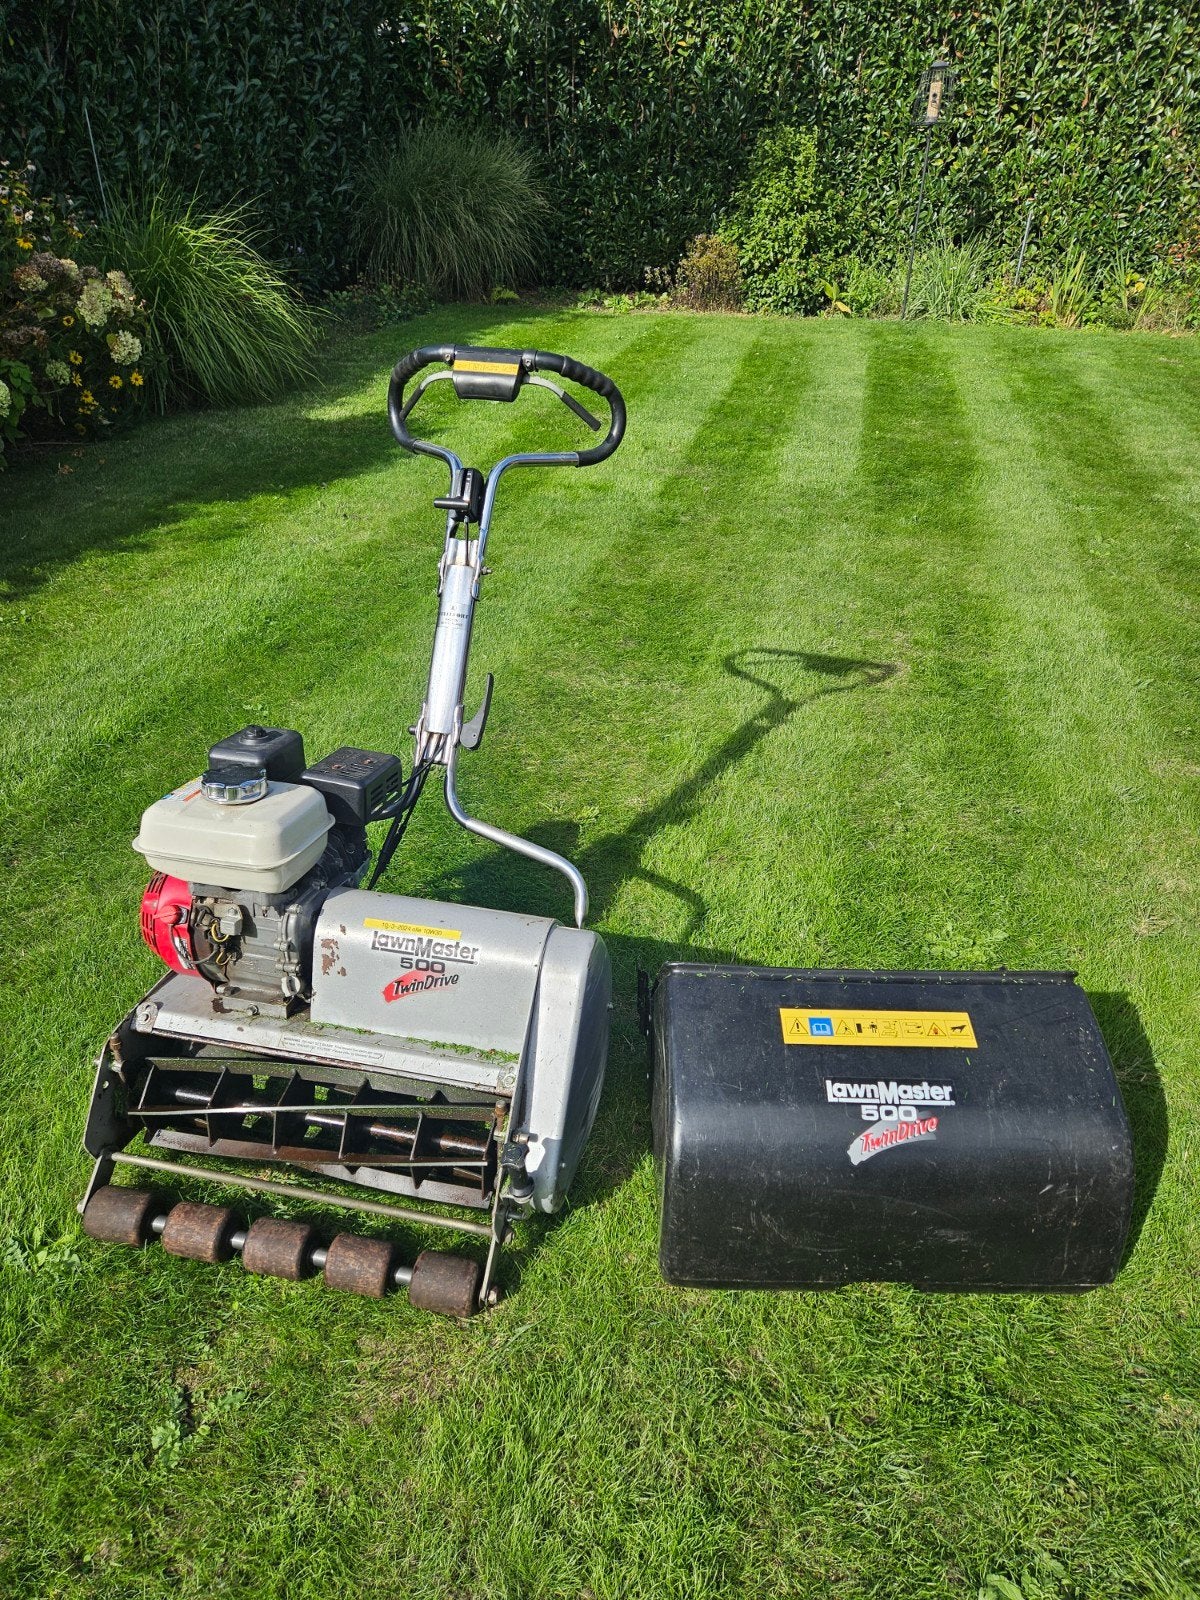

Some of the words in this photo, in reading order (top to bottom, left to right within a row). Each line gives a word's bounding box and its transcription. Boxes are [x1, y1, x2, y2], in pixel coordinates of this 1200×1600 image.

[371, 931, 479, 962] LawnMaster
[400, 957, 446, 974] 500
[394, 974, 459, 995] TwinDrive
[825, 1080, 953, 1105] LawnMaster
[861, 1105, 917, 1121] 500
[861, 1116, 938, 1153] TwinDrive
